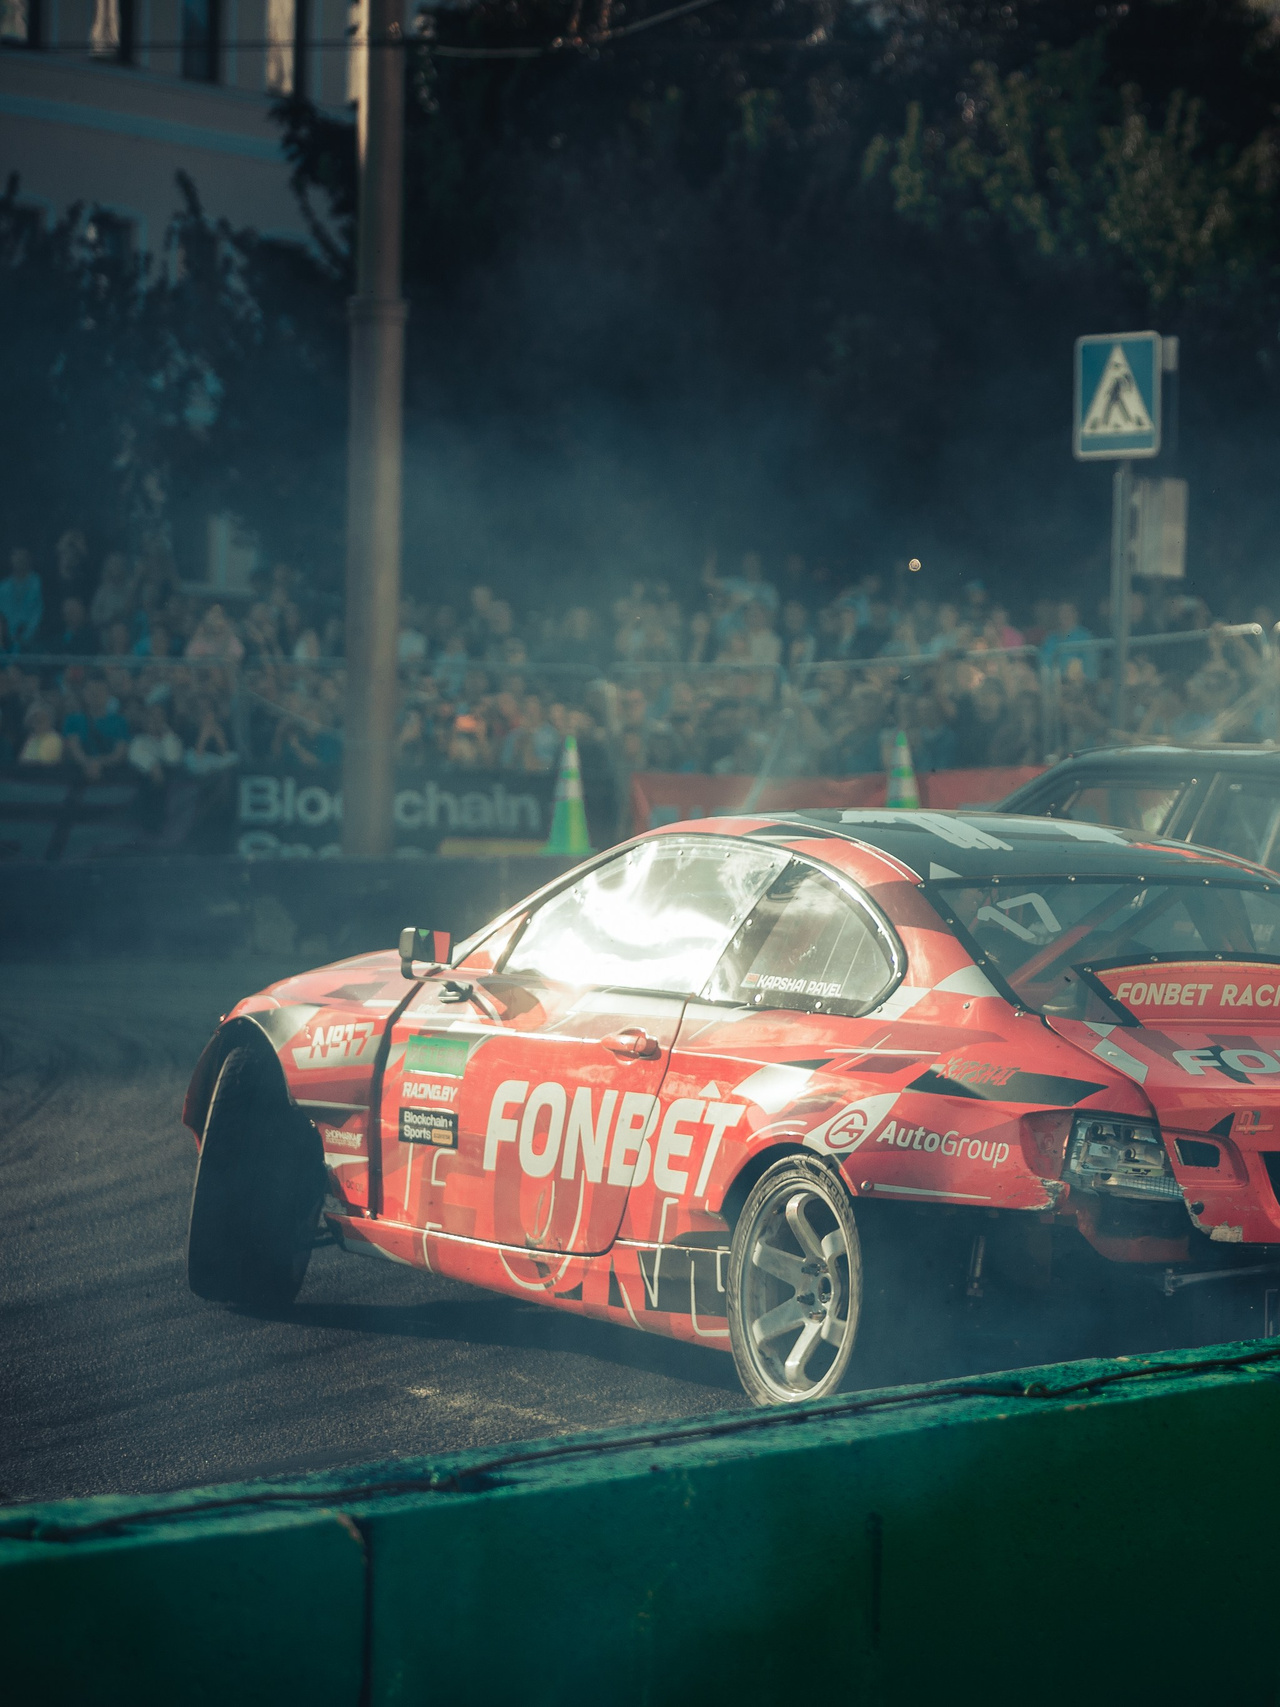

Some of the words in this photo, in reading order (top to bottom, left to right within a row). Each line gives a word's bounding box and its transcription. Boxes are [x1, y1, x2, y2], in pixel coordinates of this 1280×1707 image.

[240, 775, 542, 829] Blochain
[757, 974, 807, 993] KAPSHAI
[805, 981, 842, 998] PAVEL
[1116, 982, 1213, 1006] FONBET
[404, 1110, 448, 1128] Blockchain
[403, 1124, 431, 1140] Sports
[482, 1080, 746, 1197] FONBET
[876, 1121, 1010, 1168] AutoGroup
